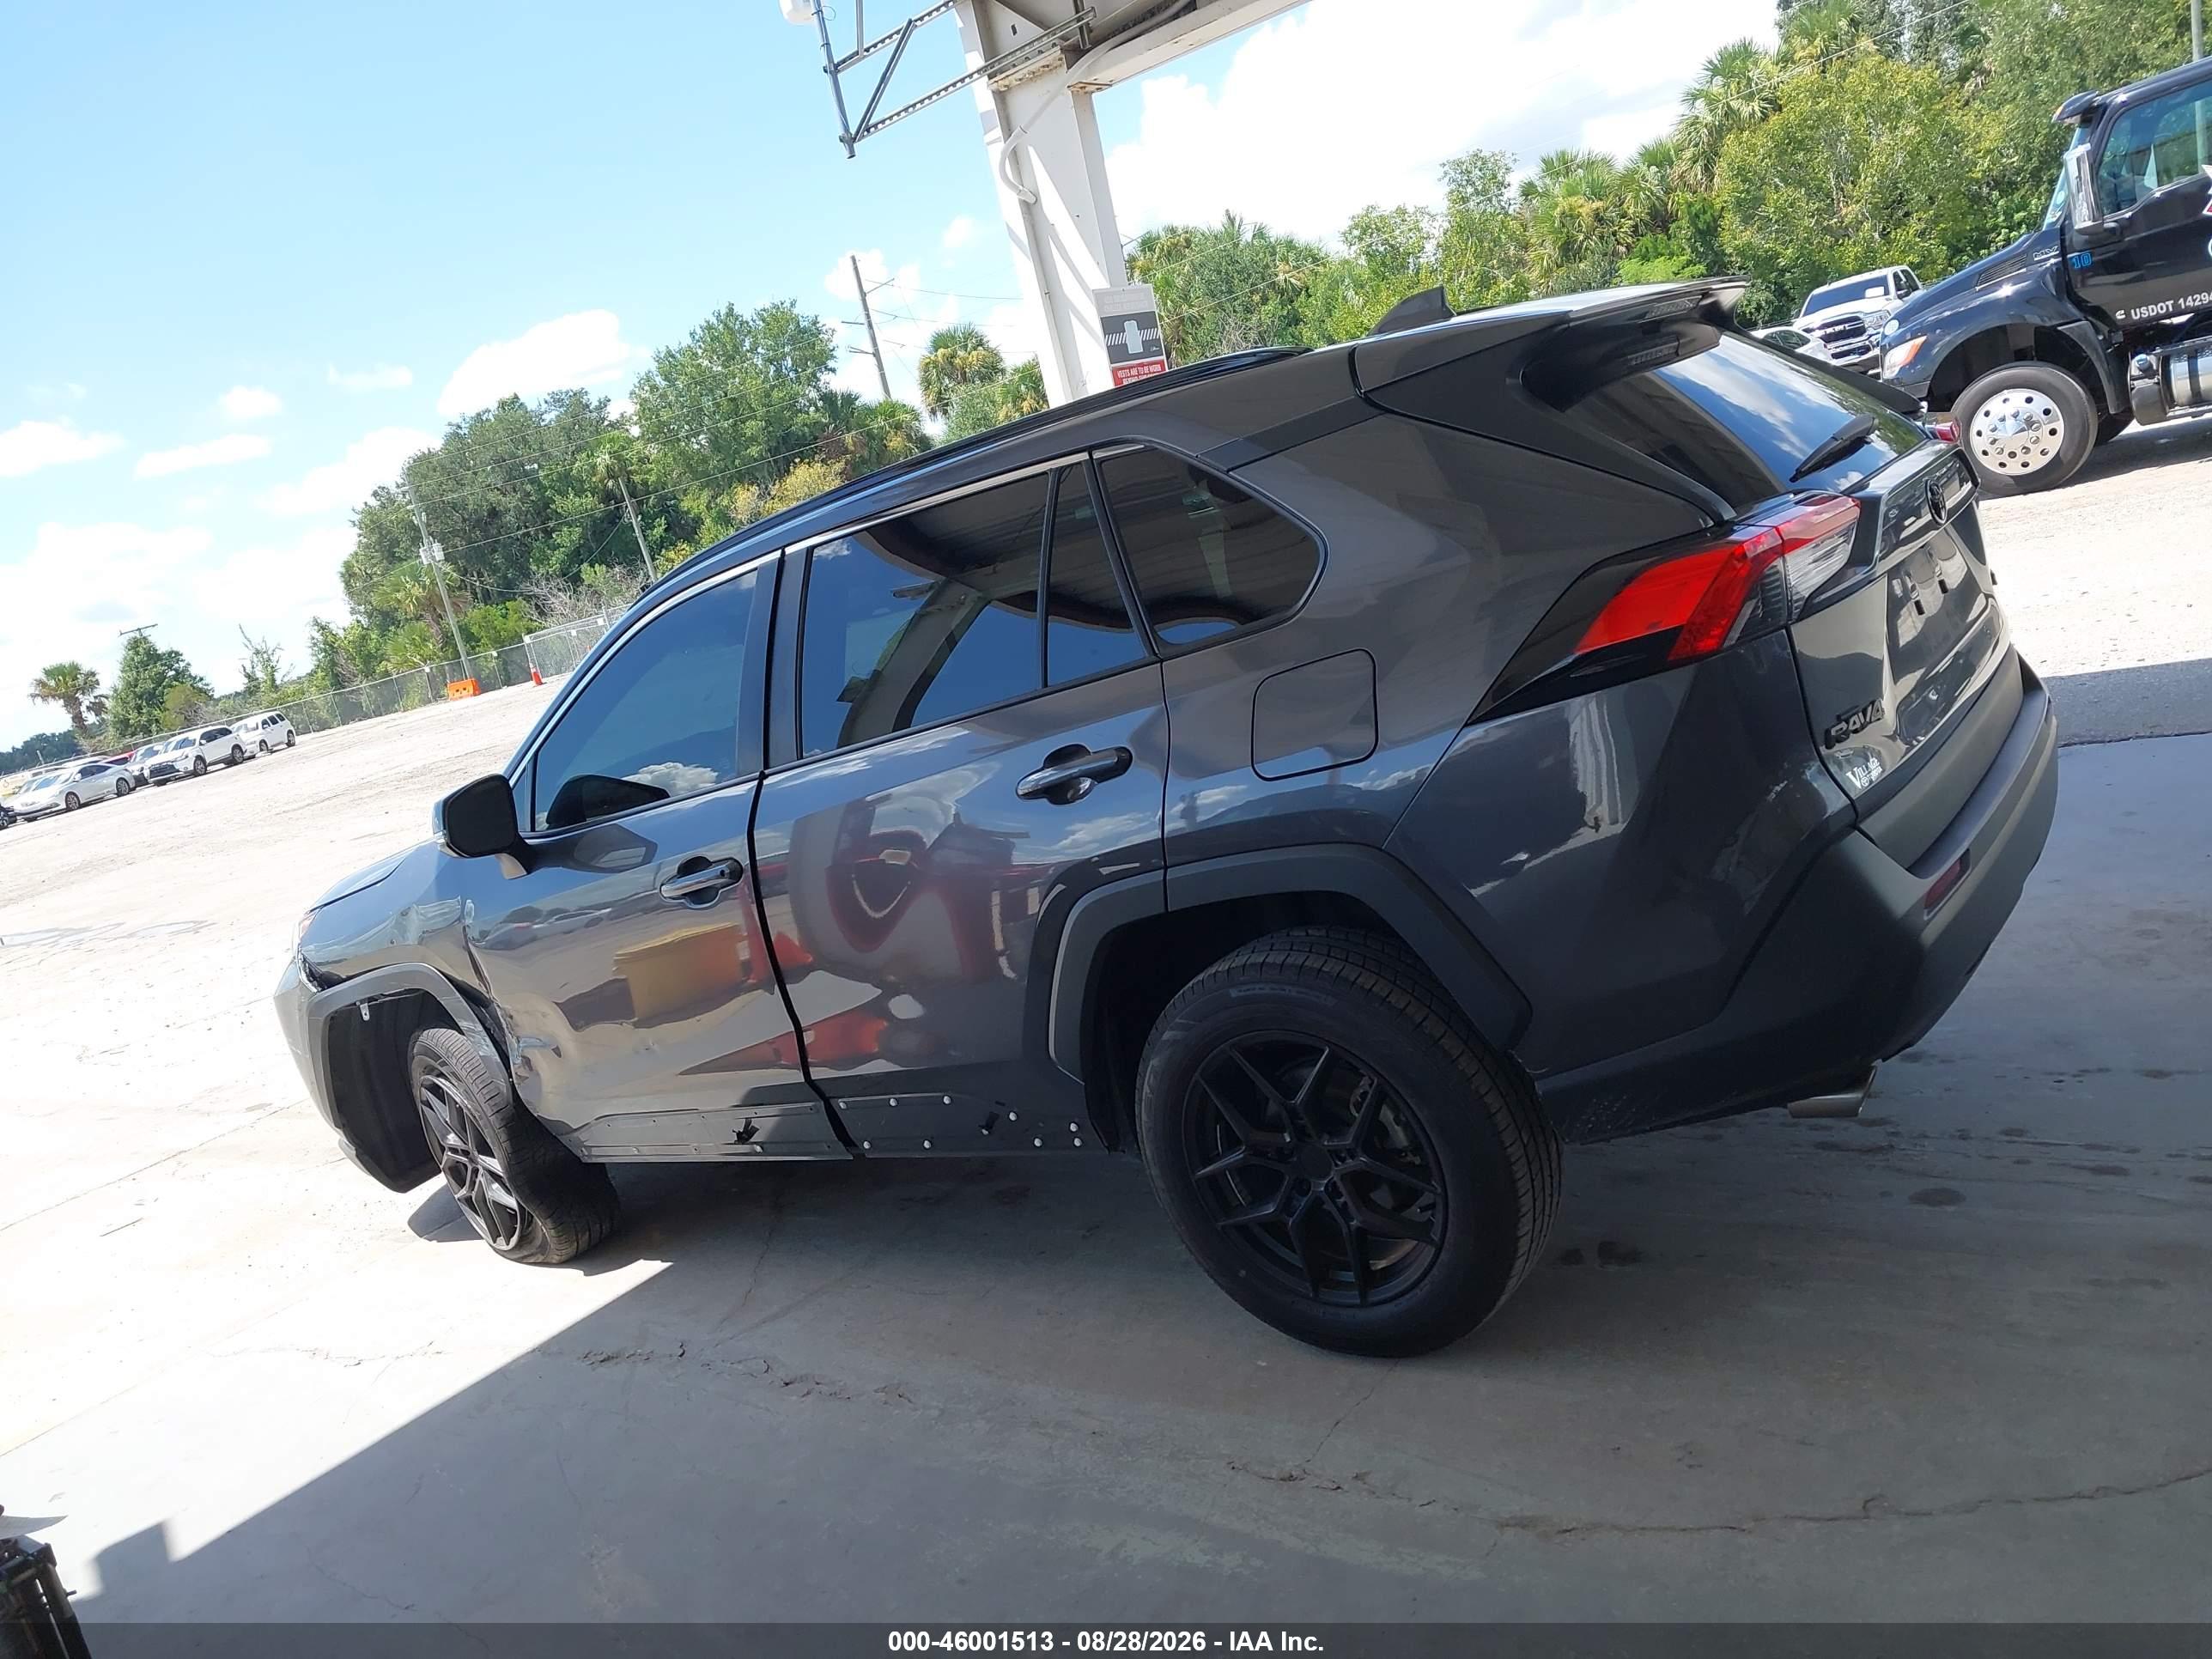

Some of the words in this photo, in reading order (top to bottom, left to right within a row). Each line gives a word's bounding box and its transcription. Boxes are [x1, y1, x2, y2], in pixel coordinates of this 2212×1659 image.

[2073, 252, 2092, 269] 10
[2130, 300, 2174, 319] USDOT
[1824, 698, 1885, 750] RAV4
